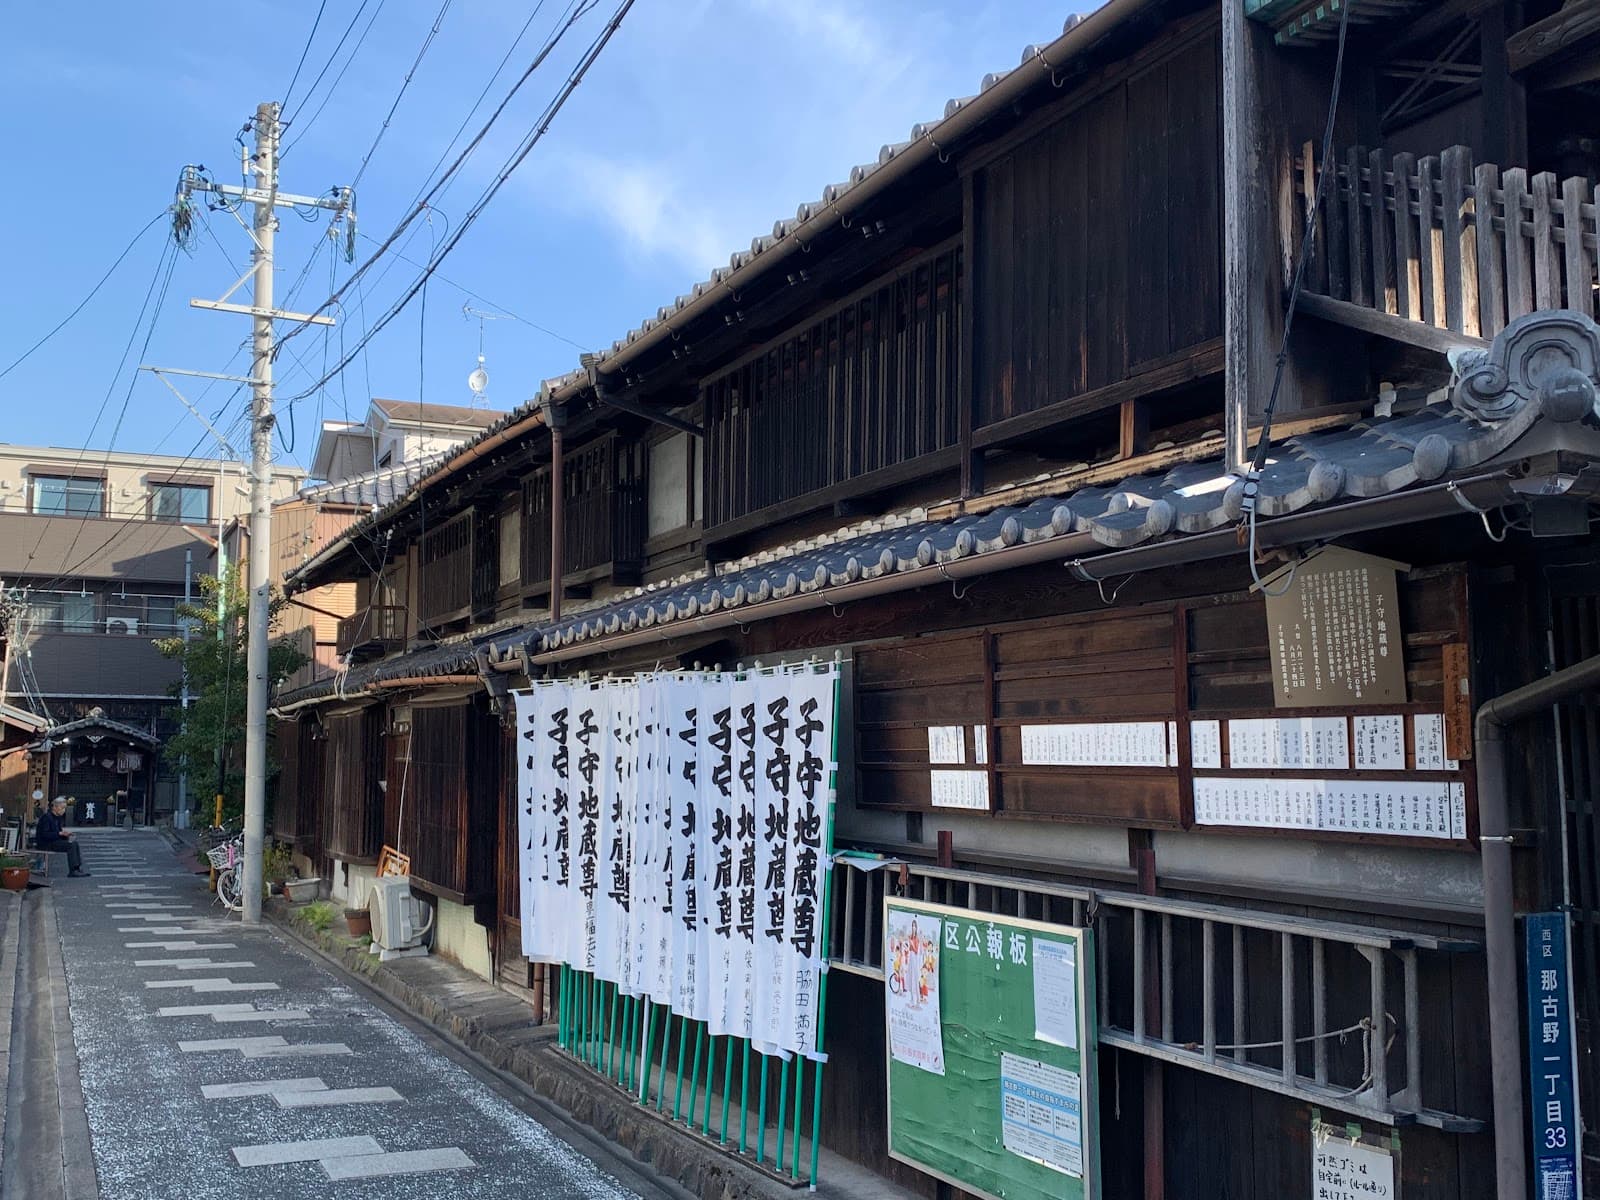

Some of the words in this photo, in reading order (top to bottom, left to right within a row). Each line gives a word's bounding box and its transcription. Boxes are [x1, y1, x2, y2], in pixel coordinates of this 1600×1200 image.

[576, 708, 600, 900] 子守地蔵尊
[790, 697, 825, 959] 子守地蔵尊
[945, 918, 1027, 966] 区公報板
[1541, 929, 1553, 957] 西区
[1541, 969, 1563, 1123] 那古野一丁目
[1545, 1127, 1567, 1149] 33
